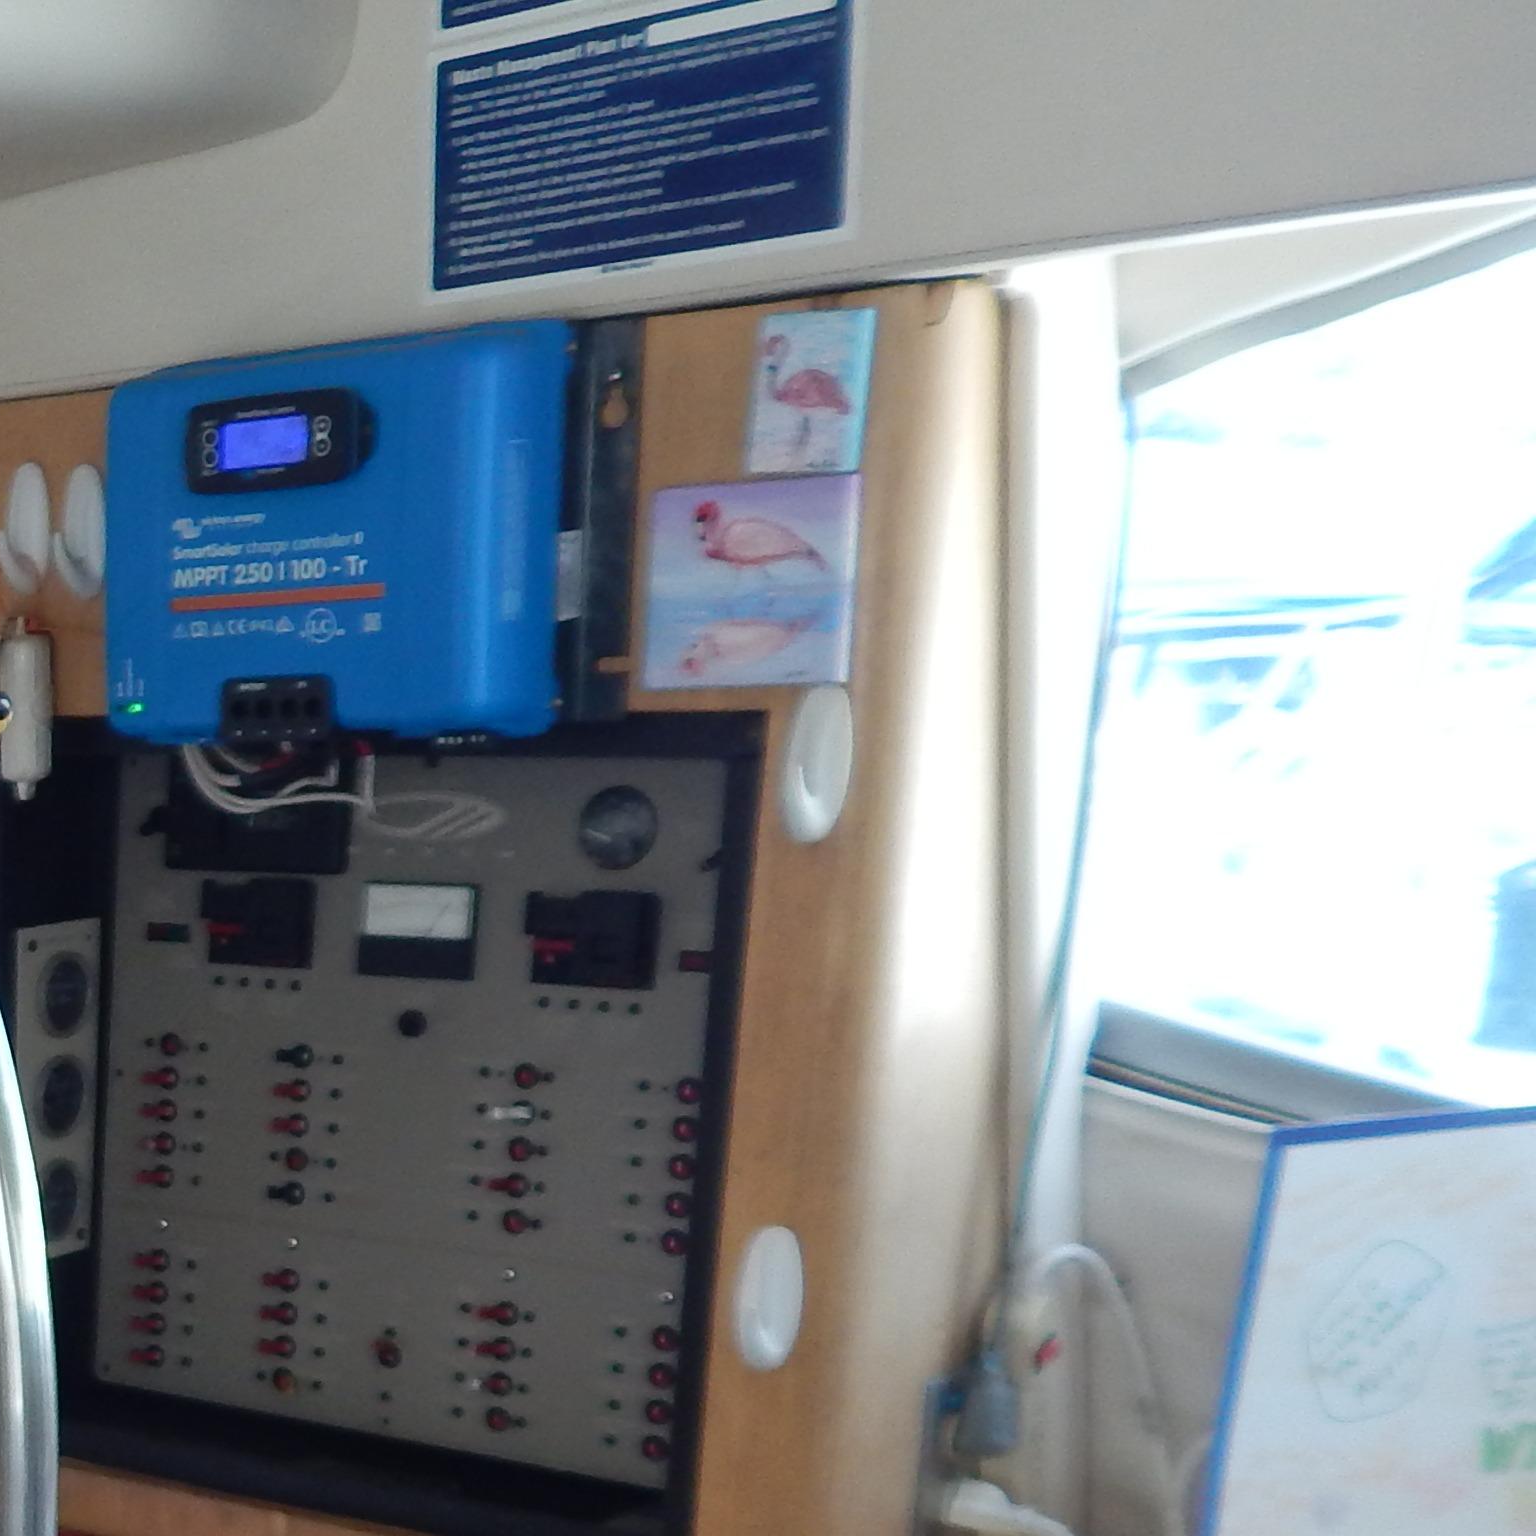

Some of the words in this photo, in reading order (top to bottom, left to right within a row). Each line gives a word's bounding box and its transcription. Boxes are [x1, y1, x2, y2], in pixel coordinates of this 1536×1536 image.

[173, 565, 229, 588] MPPT
[234, 561, 273, 584] 250
[291, 557, 326, 580] 100
[344, 555, 368, 576] Tr
